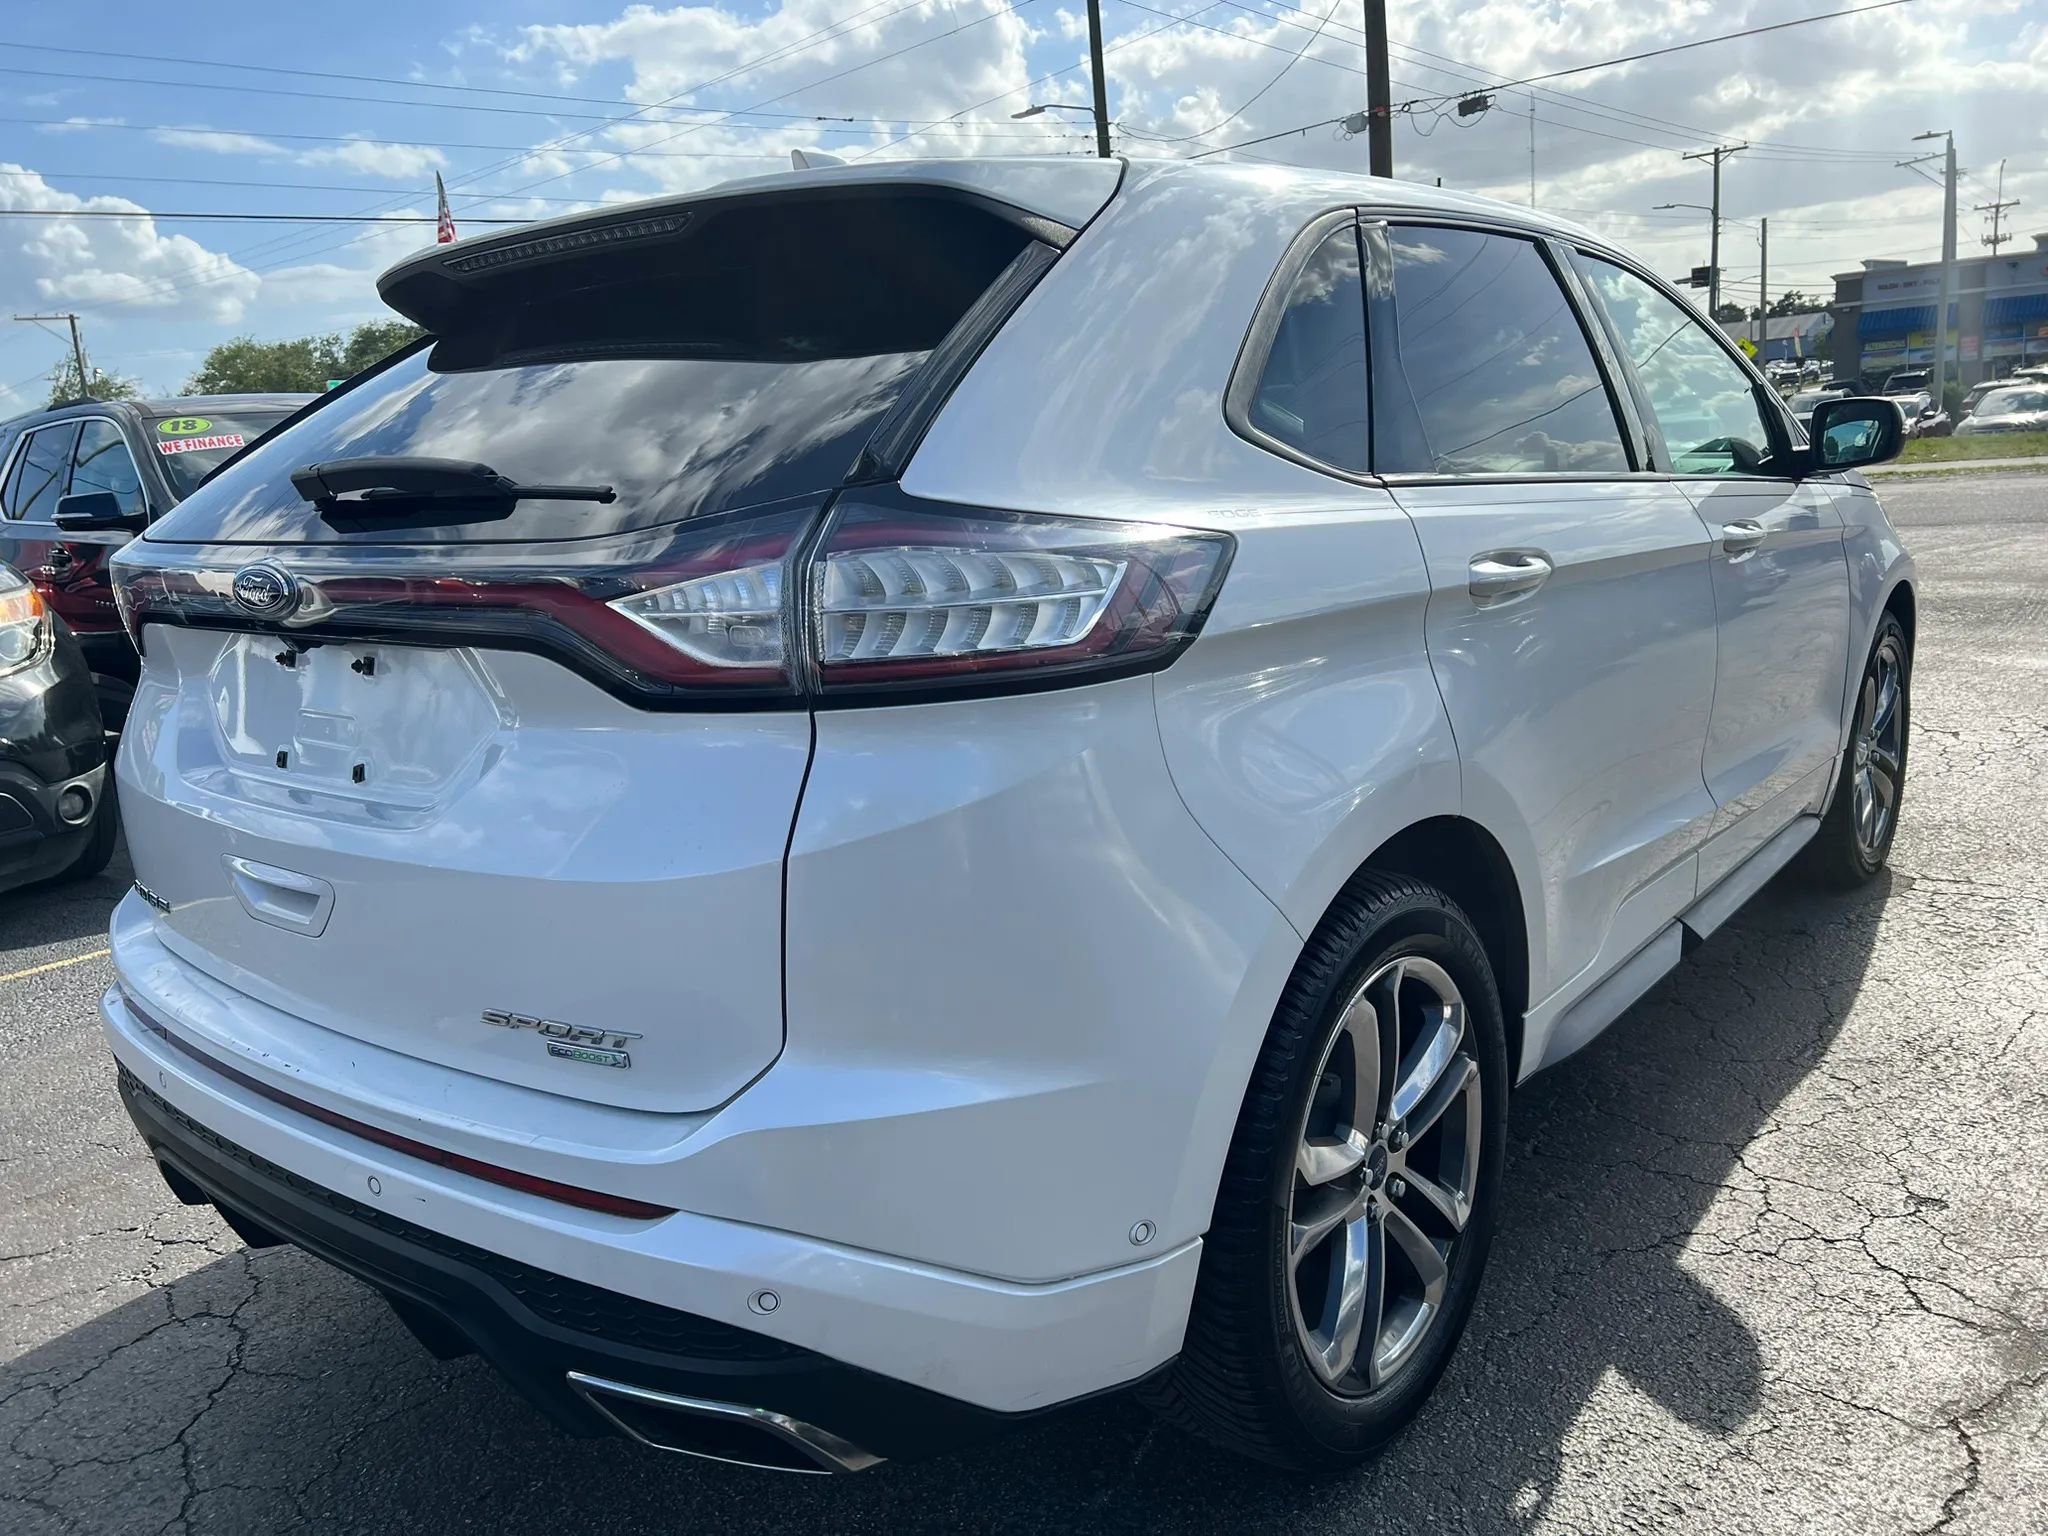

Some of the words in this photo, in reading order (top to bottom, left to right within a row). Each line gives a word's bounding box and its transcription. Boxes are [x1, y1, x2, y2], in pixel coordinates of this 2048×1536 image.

[169, 420, 198, 432] 18
[160, 441, 183, 454] WE
[185, 435, 243, 451] FINANCE
[236, 575, 279, 602] Ford
[480, 1008, 644, 1048] SPORT
[550, 1046, 610, 1064] ECOBOOST
